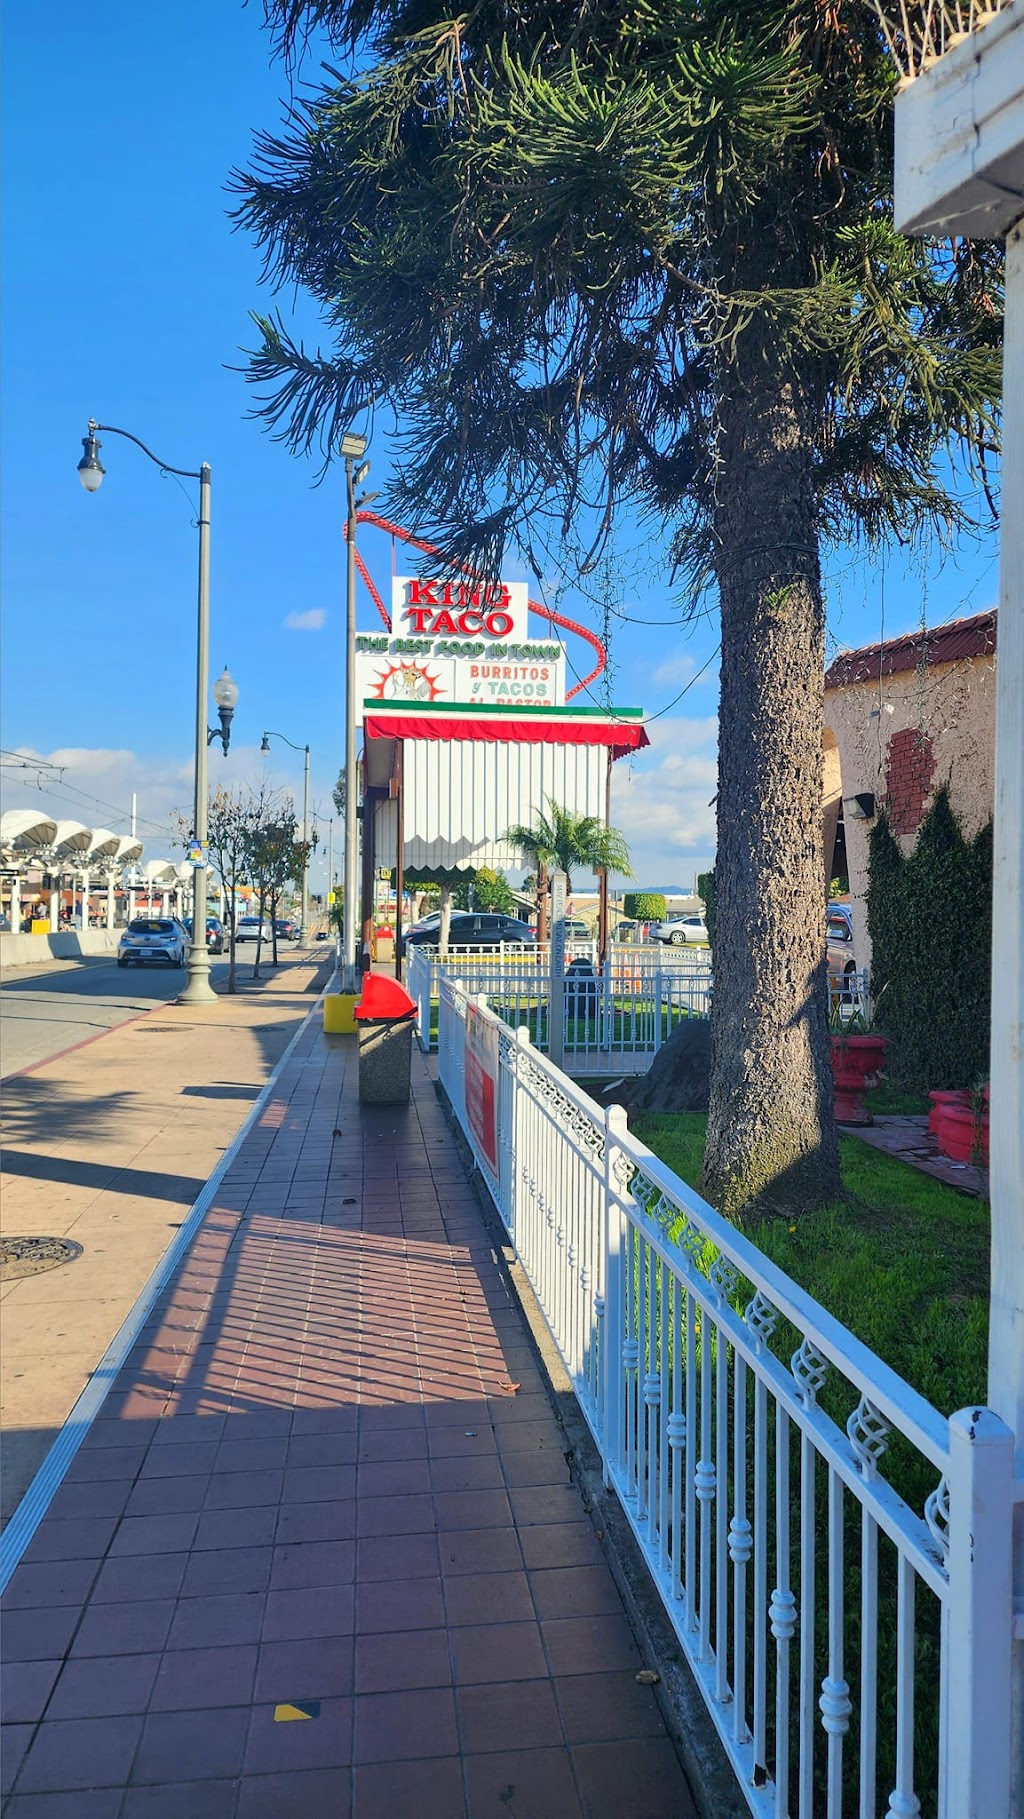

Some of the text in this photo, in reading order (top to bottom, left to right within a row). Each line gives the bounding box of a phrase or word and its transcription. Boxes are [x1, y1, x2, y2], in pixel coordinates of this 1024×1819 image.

[408, 579, 512, 609] KING
[406, 607, 515, 636] TACO
[356, 636, 561, 659] THE BEST FOOD IN TOWN
[470, 665, 549, 681] BURRITOS
[488, 682, 547, 697] TACOS
[555, 884, 563, 898] MAY
[555, 899, 563, 919] PEACE
[555, 920, 563, 944] PREVAIL
[555, 955, 563, 977] EARTH
